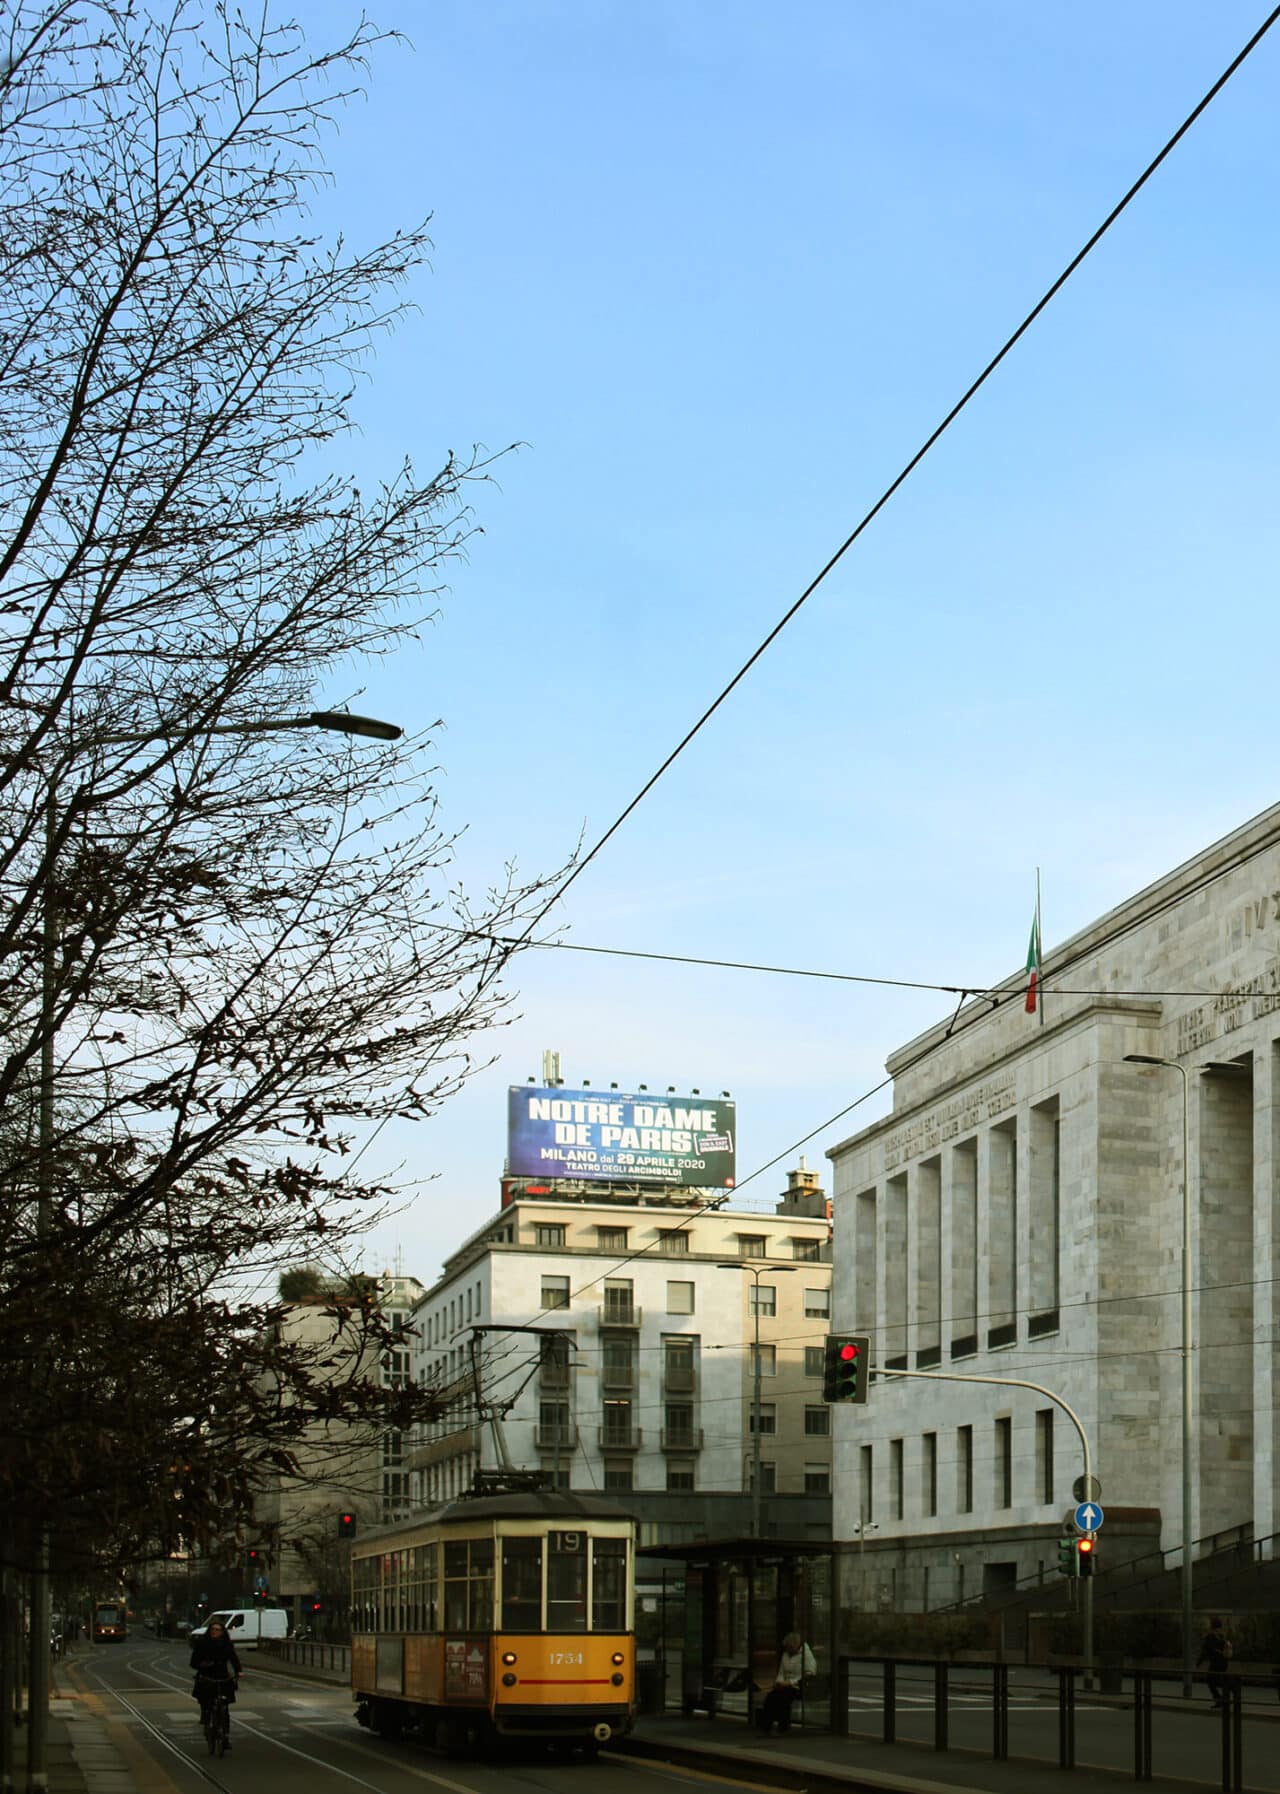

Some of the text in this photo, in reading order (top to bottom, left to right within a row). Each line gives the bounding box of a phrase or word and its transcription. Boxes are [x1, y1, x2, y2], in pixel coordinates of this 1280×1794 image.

[528, 1098, 624, 1126] NOTRE
[633, 1105, 717, 1132] DAME
[555, 1123, 692, 1153] DE PARIS
[541, 1148, 597, 1162] MILANO
[637, 1156, 675, 1167] APRILE
[677, 1159, 706, 1169] 2020
[566, 1162, 600, 1172] TEATRO
[601, 1164, 627, 1174] DEGLI
[628, 1166, 682, 1177] ARCIMBOLDI
[556, 1532, 580, 1551] 19
[549, 1652, 583, 1665] 1754
